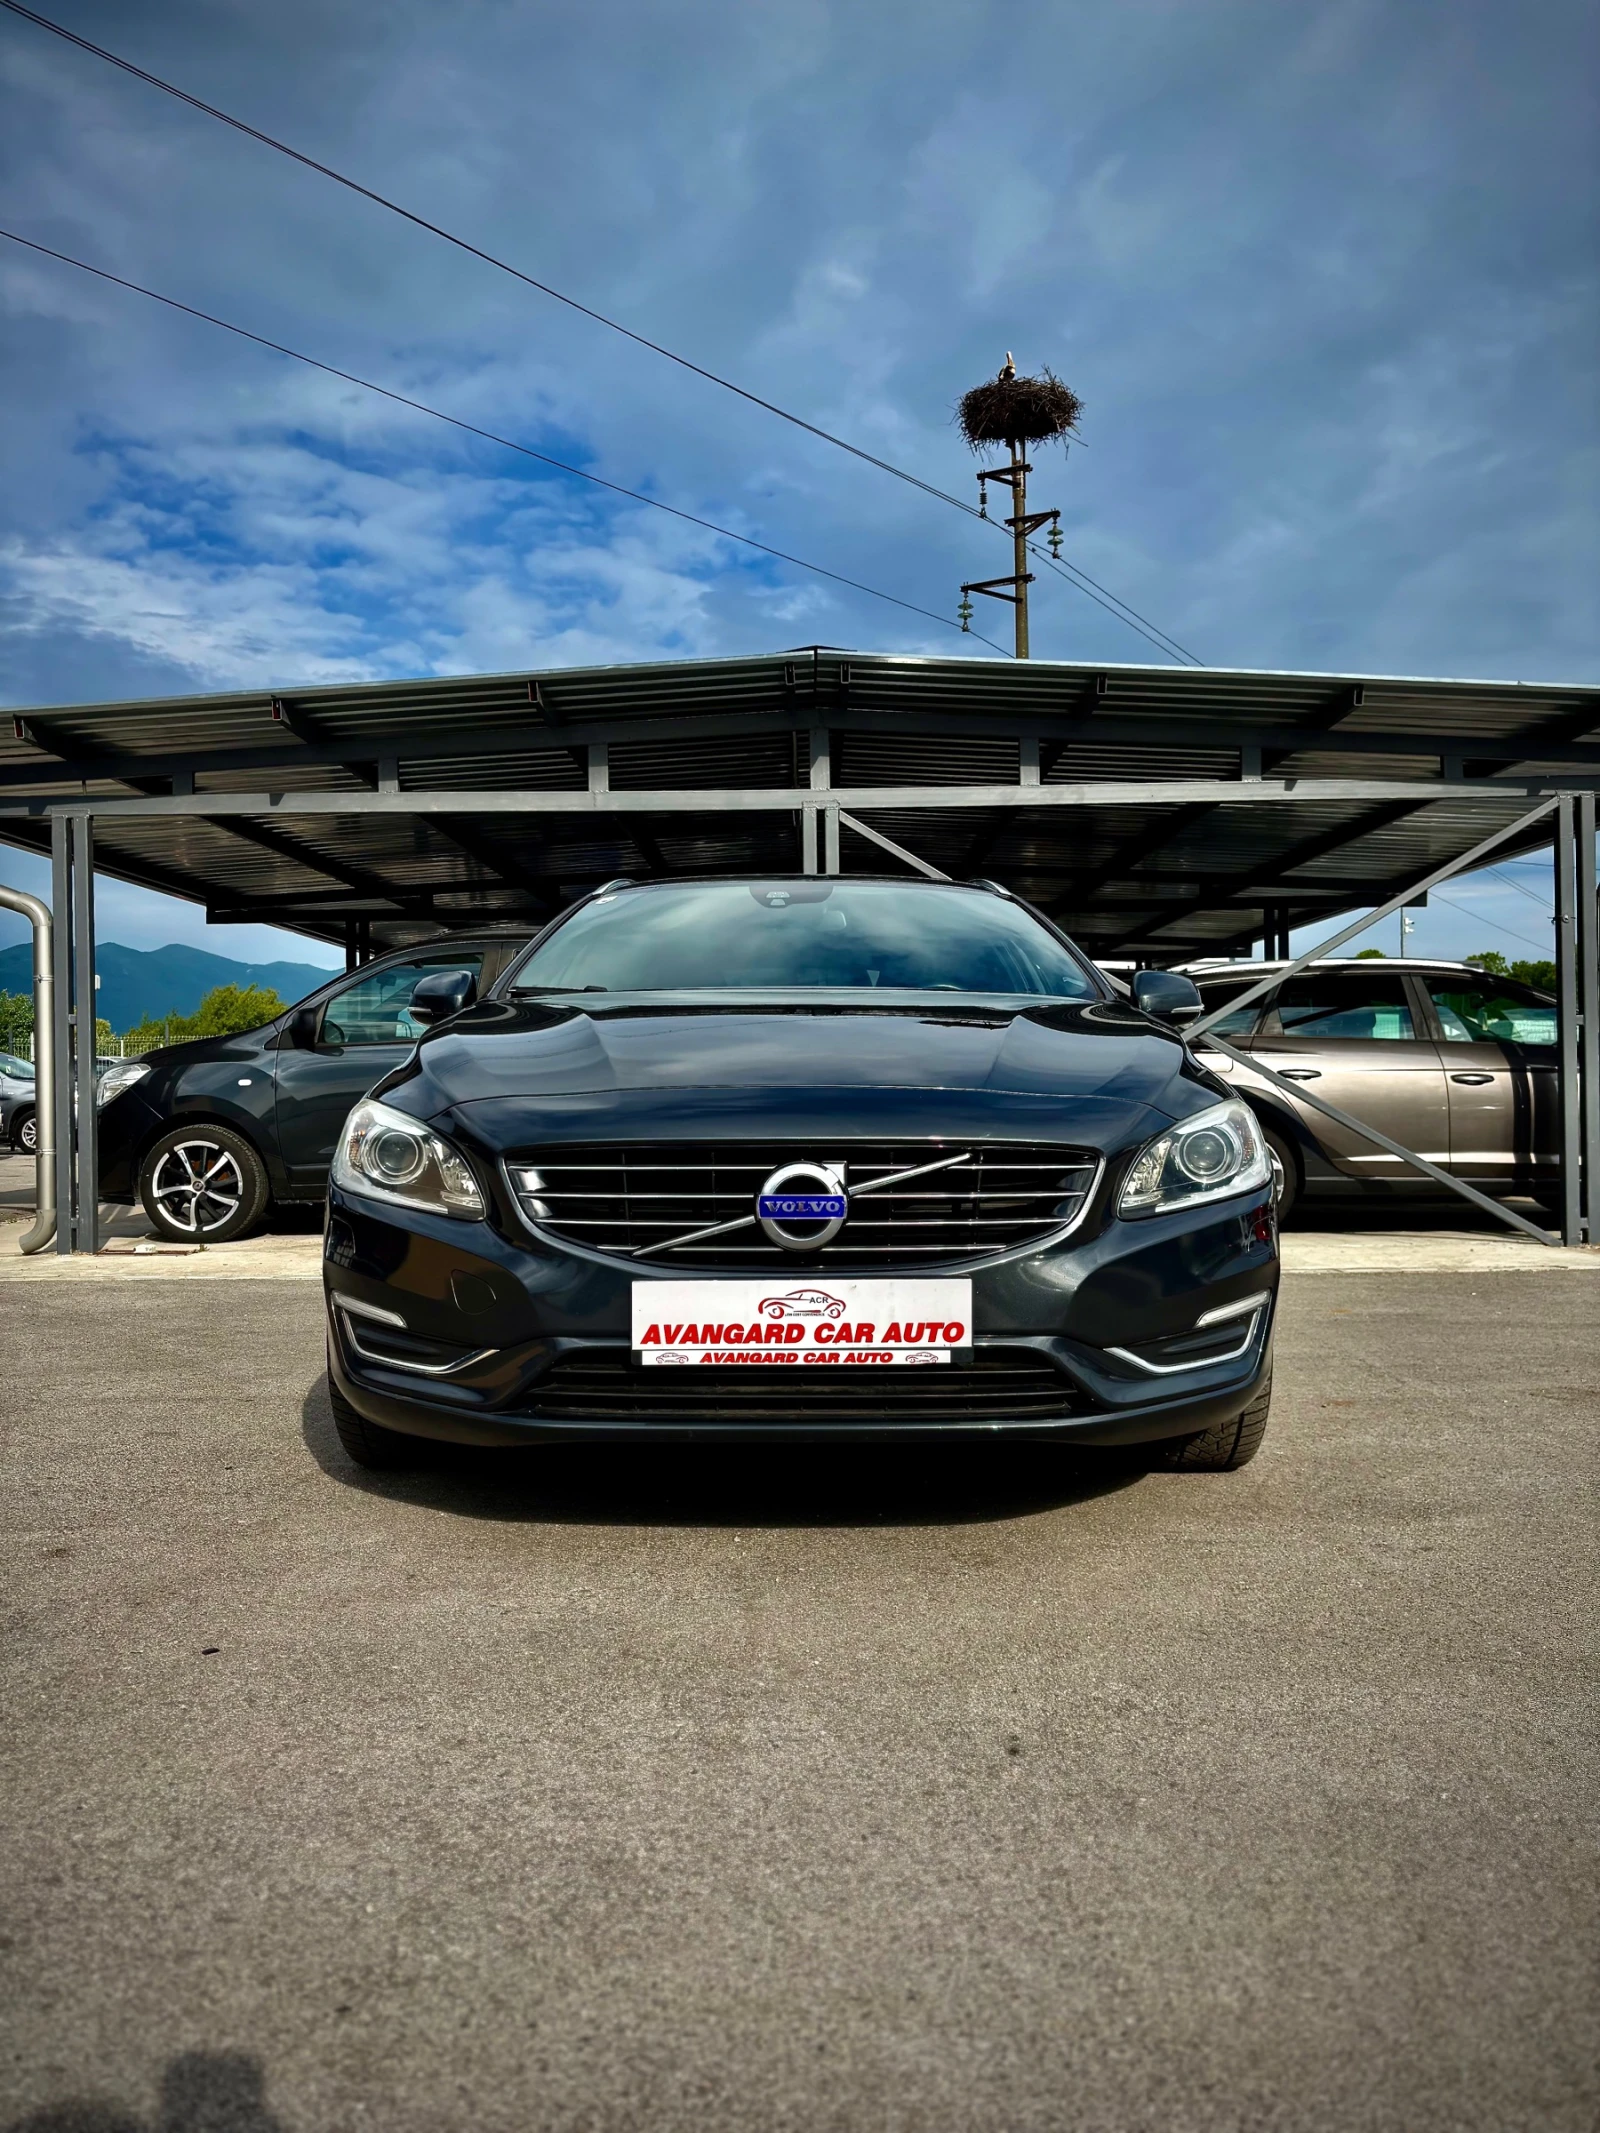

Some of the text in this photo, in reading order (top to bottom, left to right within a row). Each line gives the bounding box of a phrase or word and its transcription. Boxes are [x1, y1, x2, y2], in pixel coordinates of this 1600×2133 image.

[764, 1201, 841, 1213] VOLVO
[809, 1296, 829, 1304] ACR
[640, 1321, 965, 1345] AVANGARD CAR AUTO
[700, 1352, 894, 1364] AVANGARD CAR AUTO
